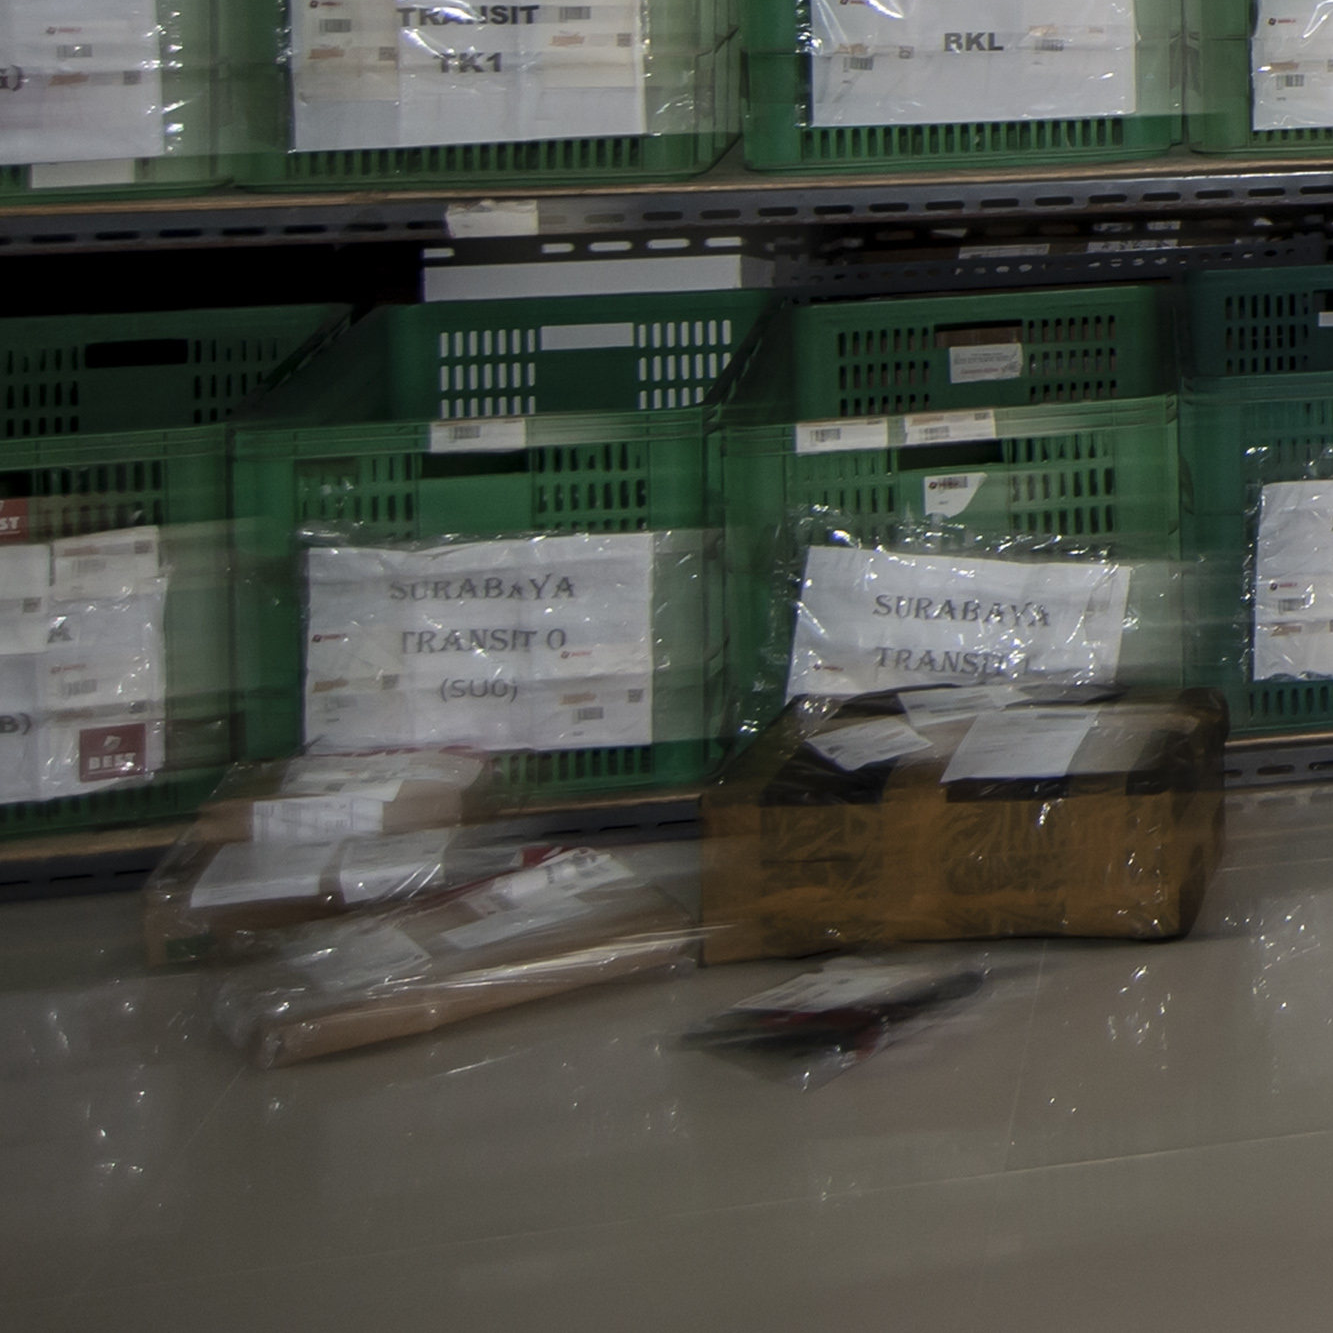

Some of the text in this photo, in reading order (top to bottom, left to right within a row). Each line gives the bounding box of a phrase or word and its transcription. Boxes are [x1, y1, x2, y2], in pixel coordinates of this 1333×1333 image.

[943, 31, 1005, 53] BKL
[433, 51, 503, 73] TK1
[389, 573, 576, 601] SURABAYA
[872, 593, 1052, 628] SURABAYA
[400, 627, 538, 654] TRANSIT
[88, 751, 137, 771] BEST
